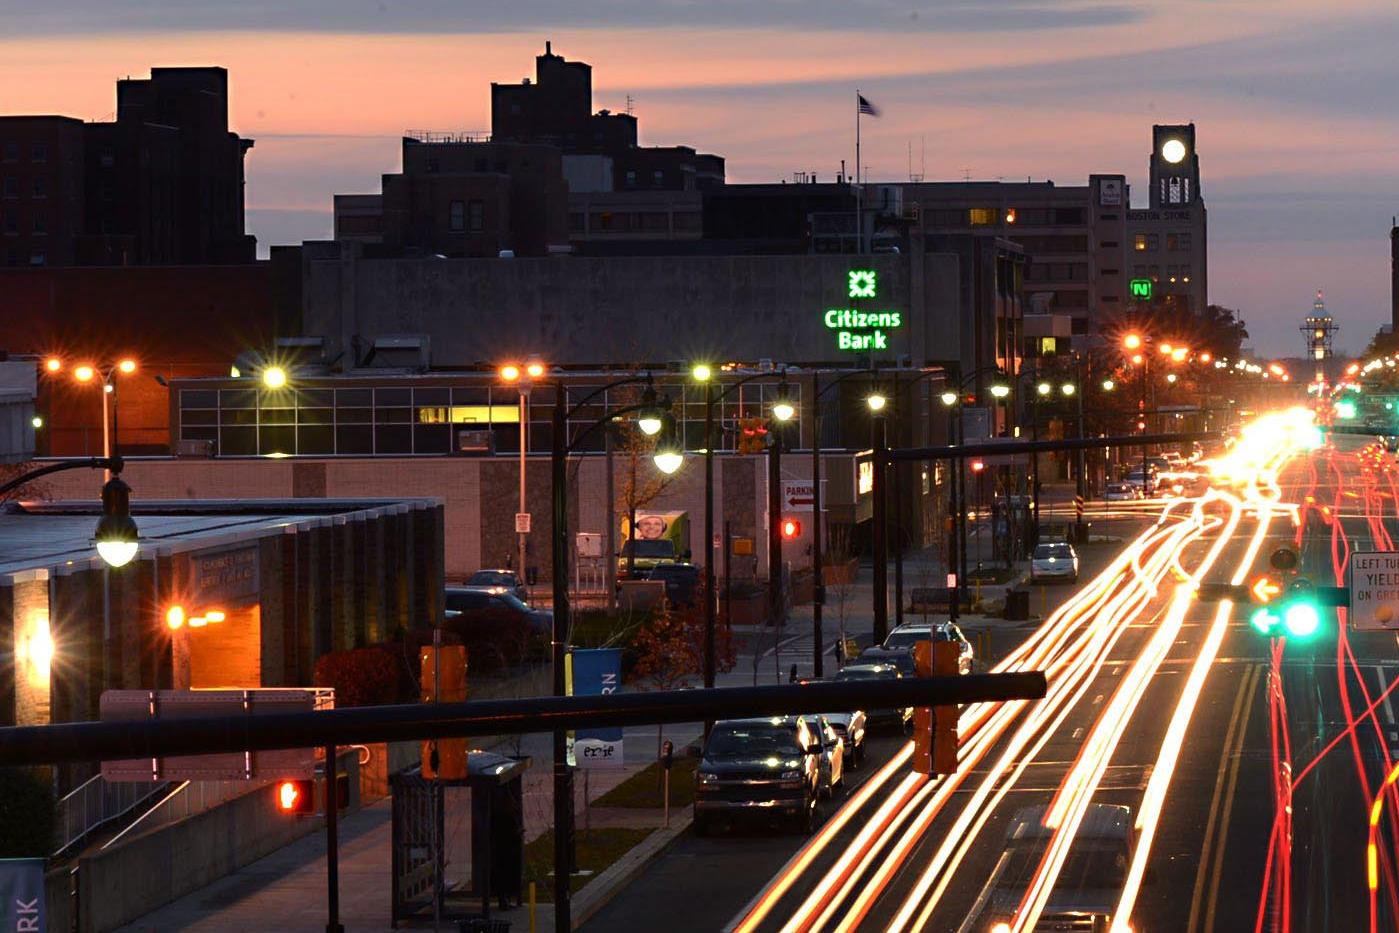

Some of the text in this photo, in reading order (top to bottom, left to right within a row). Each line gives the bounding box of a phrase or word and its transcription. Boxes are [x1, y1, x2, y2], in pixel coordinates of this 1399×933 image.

[825, 310, 900, 328] Citizens
[838, 330, 887, 349] Bank
[1356, 559, 1379, 569] LEFT
[1358, 591, 1371, 600] ON
